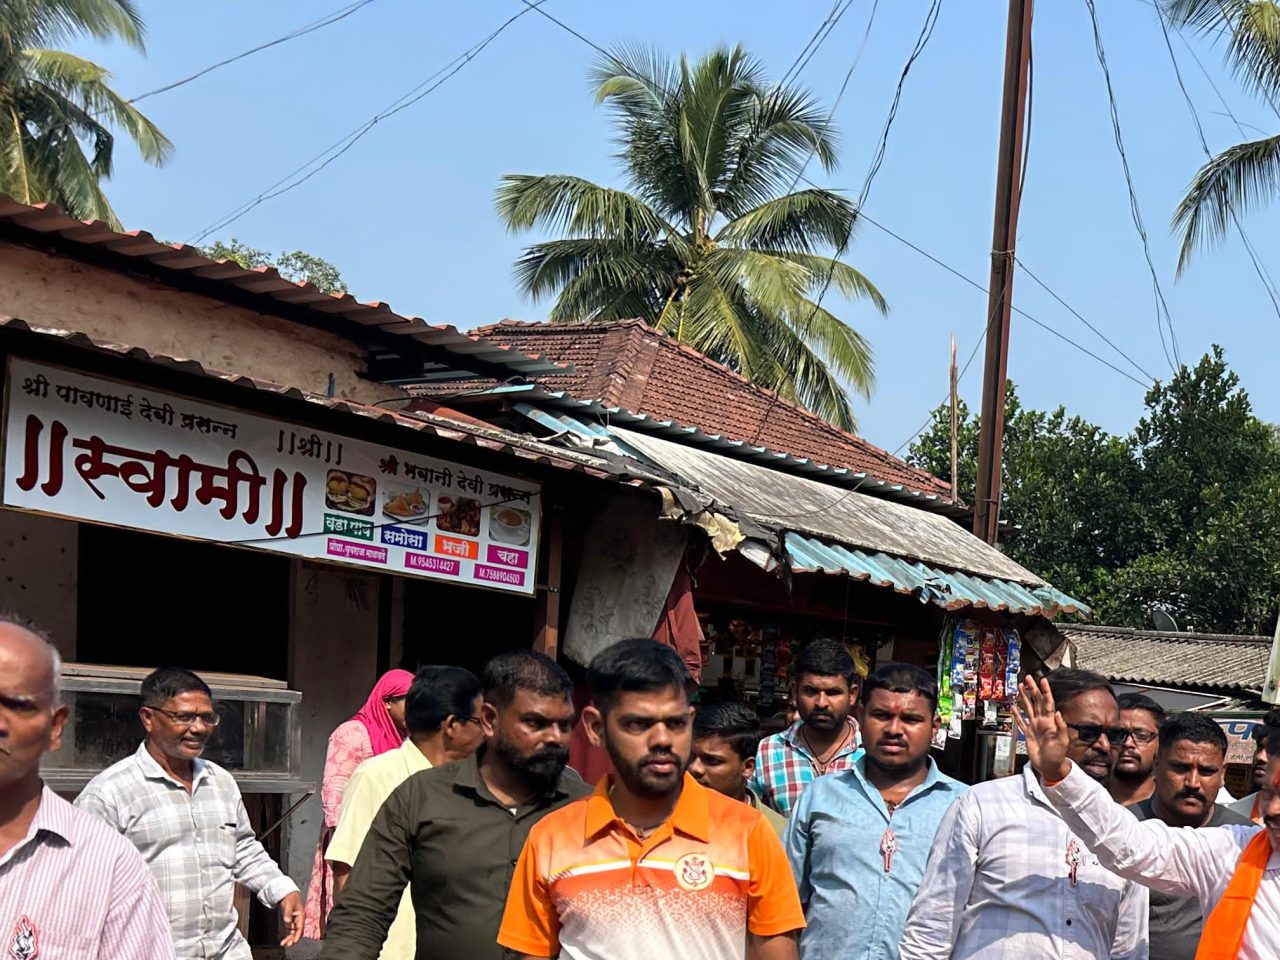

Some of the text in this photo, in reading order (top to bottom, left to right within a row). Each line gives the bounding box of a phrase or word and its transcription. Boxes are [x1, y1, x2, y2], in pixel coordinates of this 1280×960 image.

[22, 374, 238, 439] श्री पावणाई देवी प्रसन्न
[378, 454, 399, 476] श्री
[404, 461, 453, 488] भवानी
[457, 471, 484, 495] देवी
[383, 528, 423, 548] समोसा
[441, 539, 470, 557] भजी
[496, 549, 519, 566] चहा
